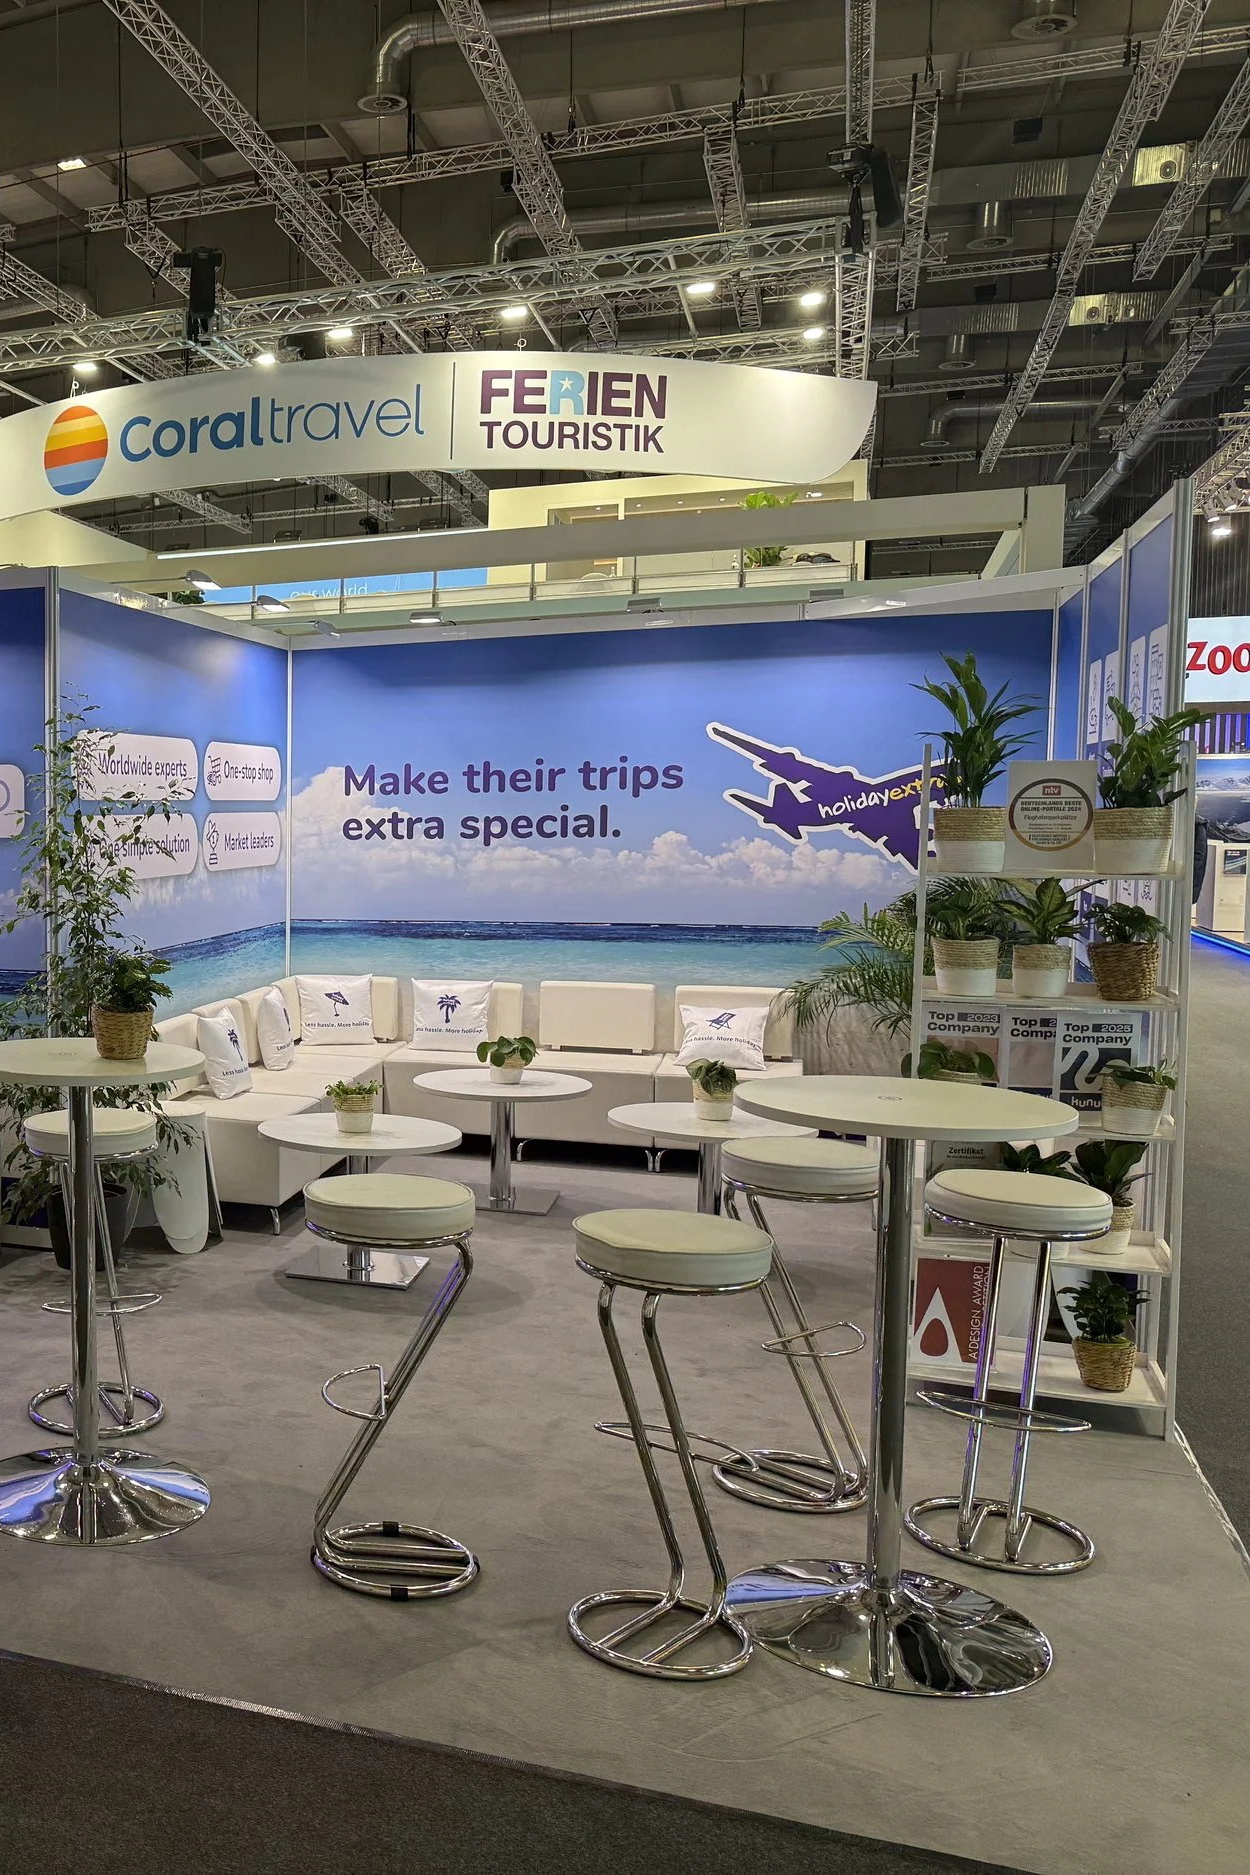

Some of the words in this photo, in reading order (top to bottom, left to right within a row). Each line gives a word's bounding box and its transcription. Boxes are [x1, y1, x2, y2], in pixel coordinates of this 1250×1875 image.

[480, 370, 668, 419] FERIEN
[480, 421, 664, 454] TOURISTIK
[99, 752, 152, 777] Worldwide
[154, 758, 188, 782] experts
[224, 760, 257, 781] One-stop
[258, 763, 274, 786] shop
[344, 763, 449, 797] Make
[462, 758, 566, 794] their
[577, 755, 684, 798] trips
[342, 811, 445, 841] extra
[459, 804, 622, 847] special.
[156, 833, 190, 855] solution
[224, 833, 249, 851] Market
[250, 831, 274, 849] leaders
[927, 1021, 1000, 1036] Company
[928, 1011, 955, 1023] Top
[966, 1013, 999, 1022] 2023
[1011, 1017, 1038, 1028] Top
[1064, 1023, 1090, 1034] Top
[1101, 1024, 1132, 1033] 2025
[1062, 1034, 1133, 1047] Company
[948, 1146, 985, 1155] Zertifikat
[971, 1265, 984, 1306] AWARD
[968, 1309, 982, 1360] A'DESIGN
